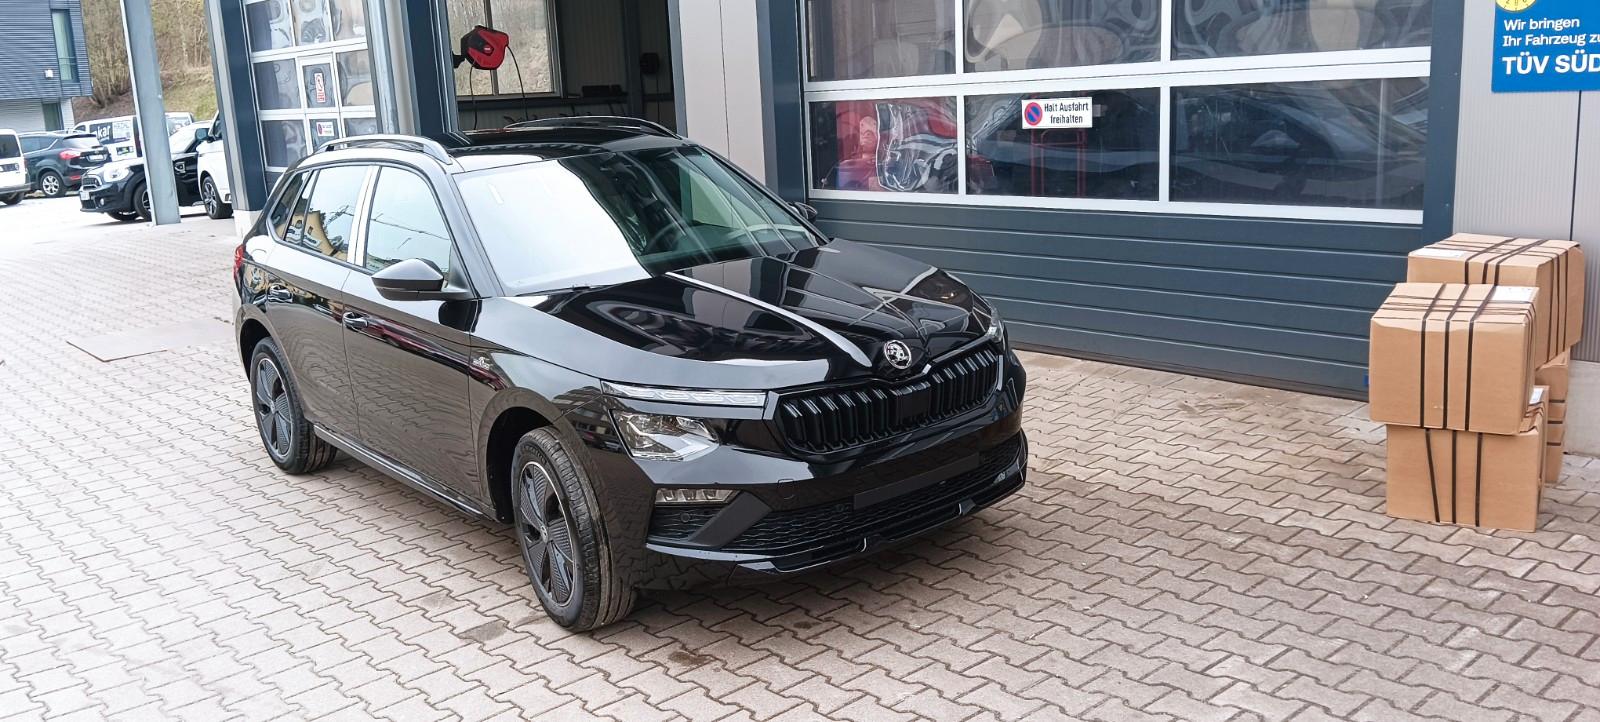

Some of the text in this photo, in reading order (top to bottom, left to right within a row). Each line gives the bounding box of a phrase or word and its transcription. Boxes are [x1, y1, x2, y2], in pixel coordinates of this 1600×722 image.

[1504, 18, 1580, 31] Wir bringen
[1502, 35, 1522, 46] Ihr
[1525, 33, 1587, 46] Fahrzeug
[1502, 49, 1600, 75] TÜV SÜD
[1044, 102, 1088, 112] Halt Ausfahrt
[1050, 115, 1083, 124] freihalten
